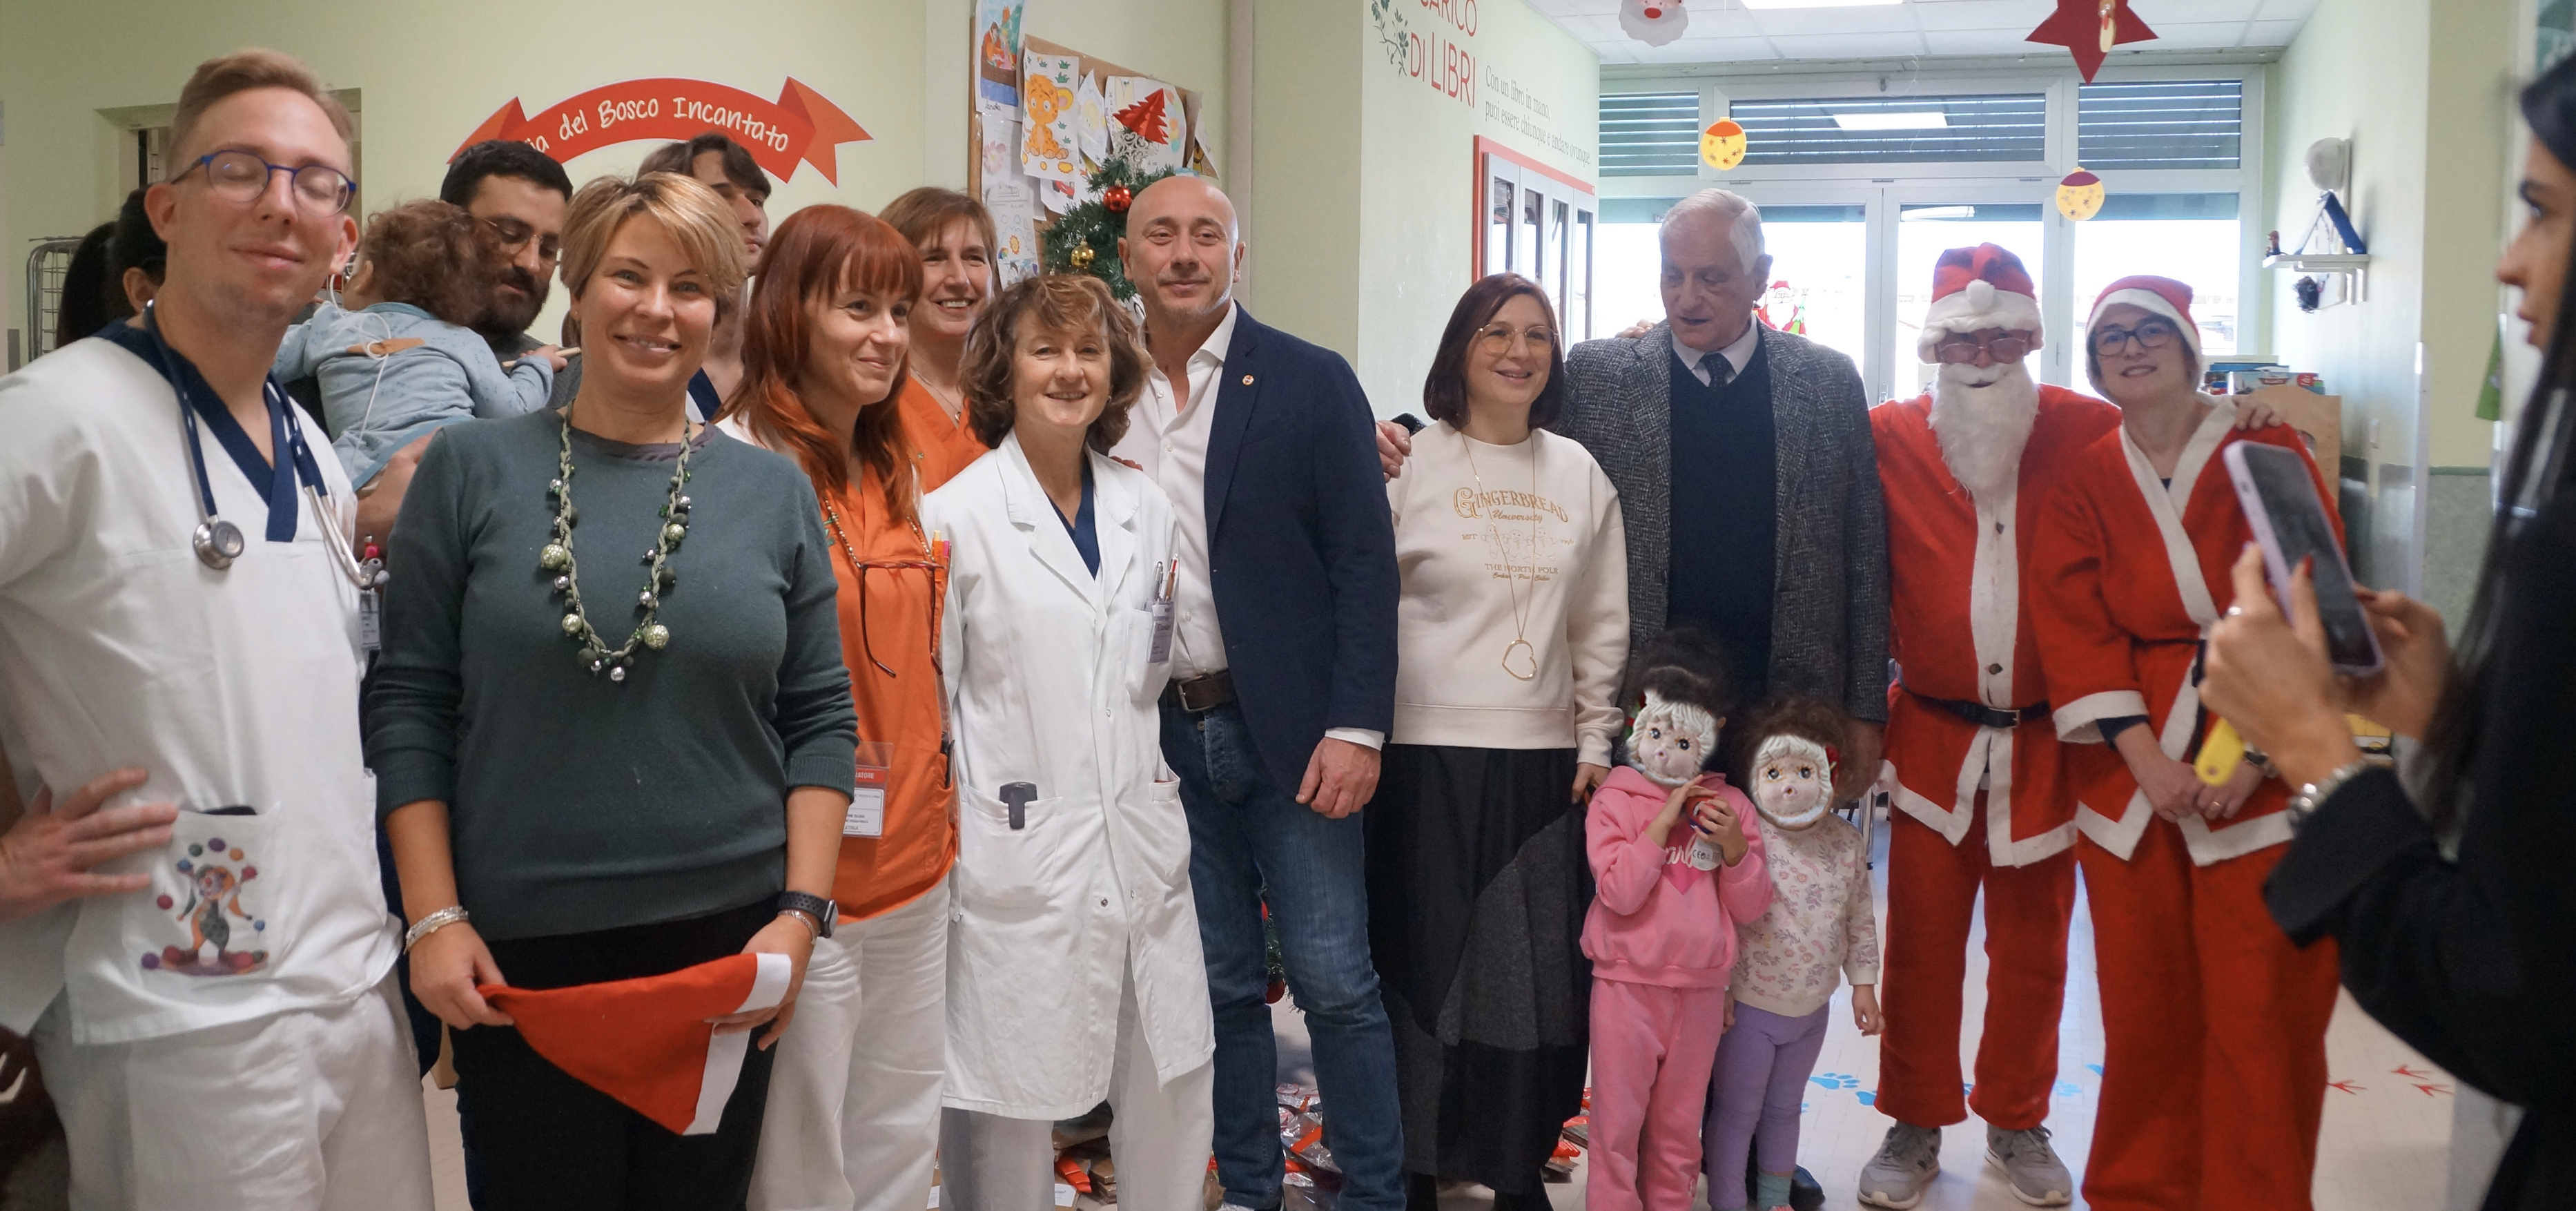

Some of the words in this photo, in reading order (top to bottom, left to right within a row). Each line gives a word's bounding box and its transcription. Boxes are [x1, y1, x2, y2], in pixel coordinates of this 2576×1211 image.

[1421, 0, 1477, 37] RICO
[1410, 32, 1425, 82] DI
[1432, 31, 1476, 108] LIBRI
[1485, 65, 1499, 92] Con
[1501, 79, 1509, 97] un
[1510, 79, 1525, 106] libro
[1526, 88, 1532, 110] in
[1533, 97, 1550, 122] mano,
[525, 135, 550, 153] ia
[559, 110, 589, 141] del
[597, 98, 658, 129] Bosco
[672, 97, 789, 153] Incantato
[1485, 100, 1500, 122] puoi
[1501, 108, 1519, 131] essere
[1521, 115, 1546, 146] chiunque
[1547, 133, 1550, 146] e
[1552, 133, 1570, 156] andare
[1570, 144, 1591, 168] ovunque.
[1504, 565, 1536, 574] NORTH
[1538, 566, 1559, 574] POLE
